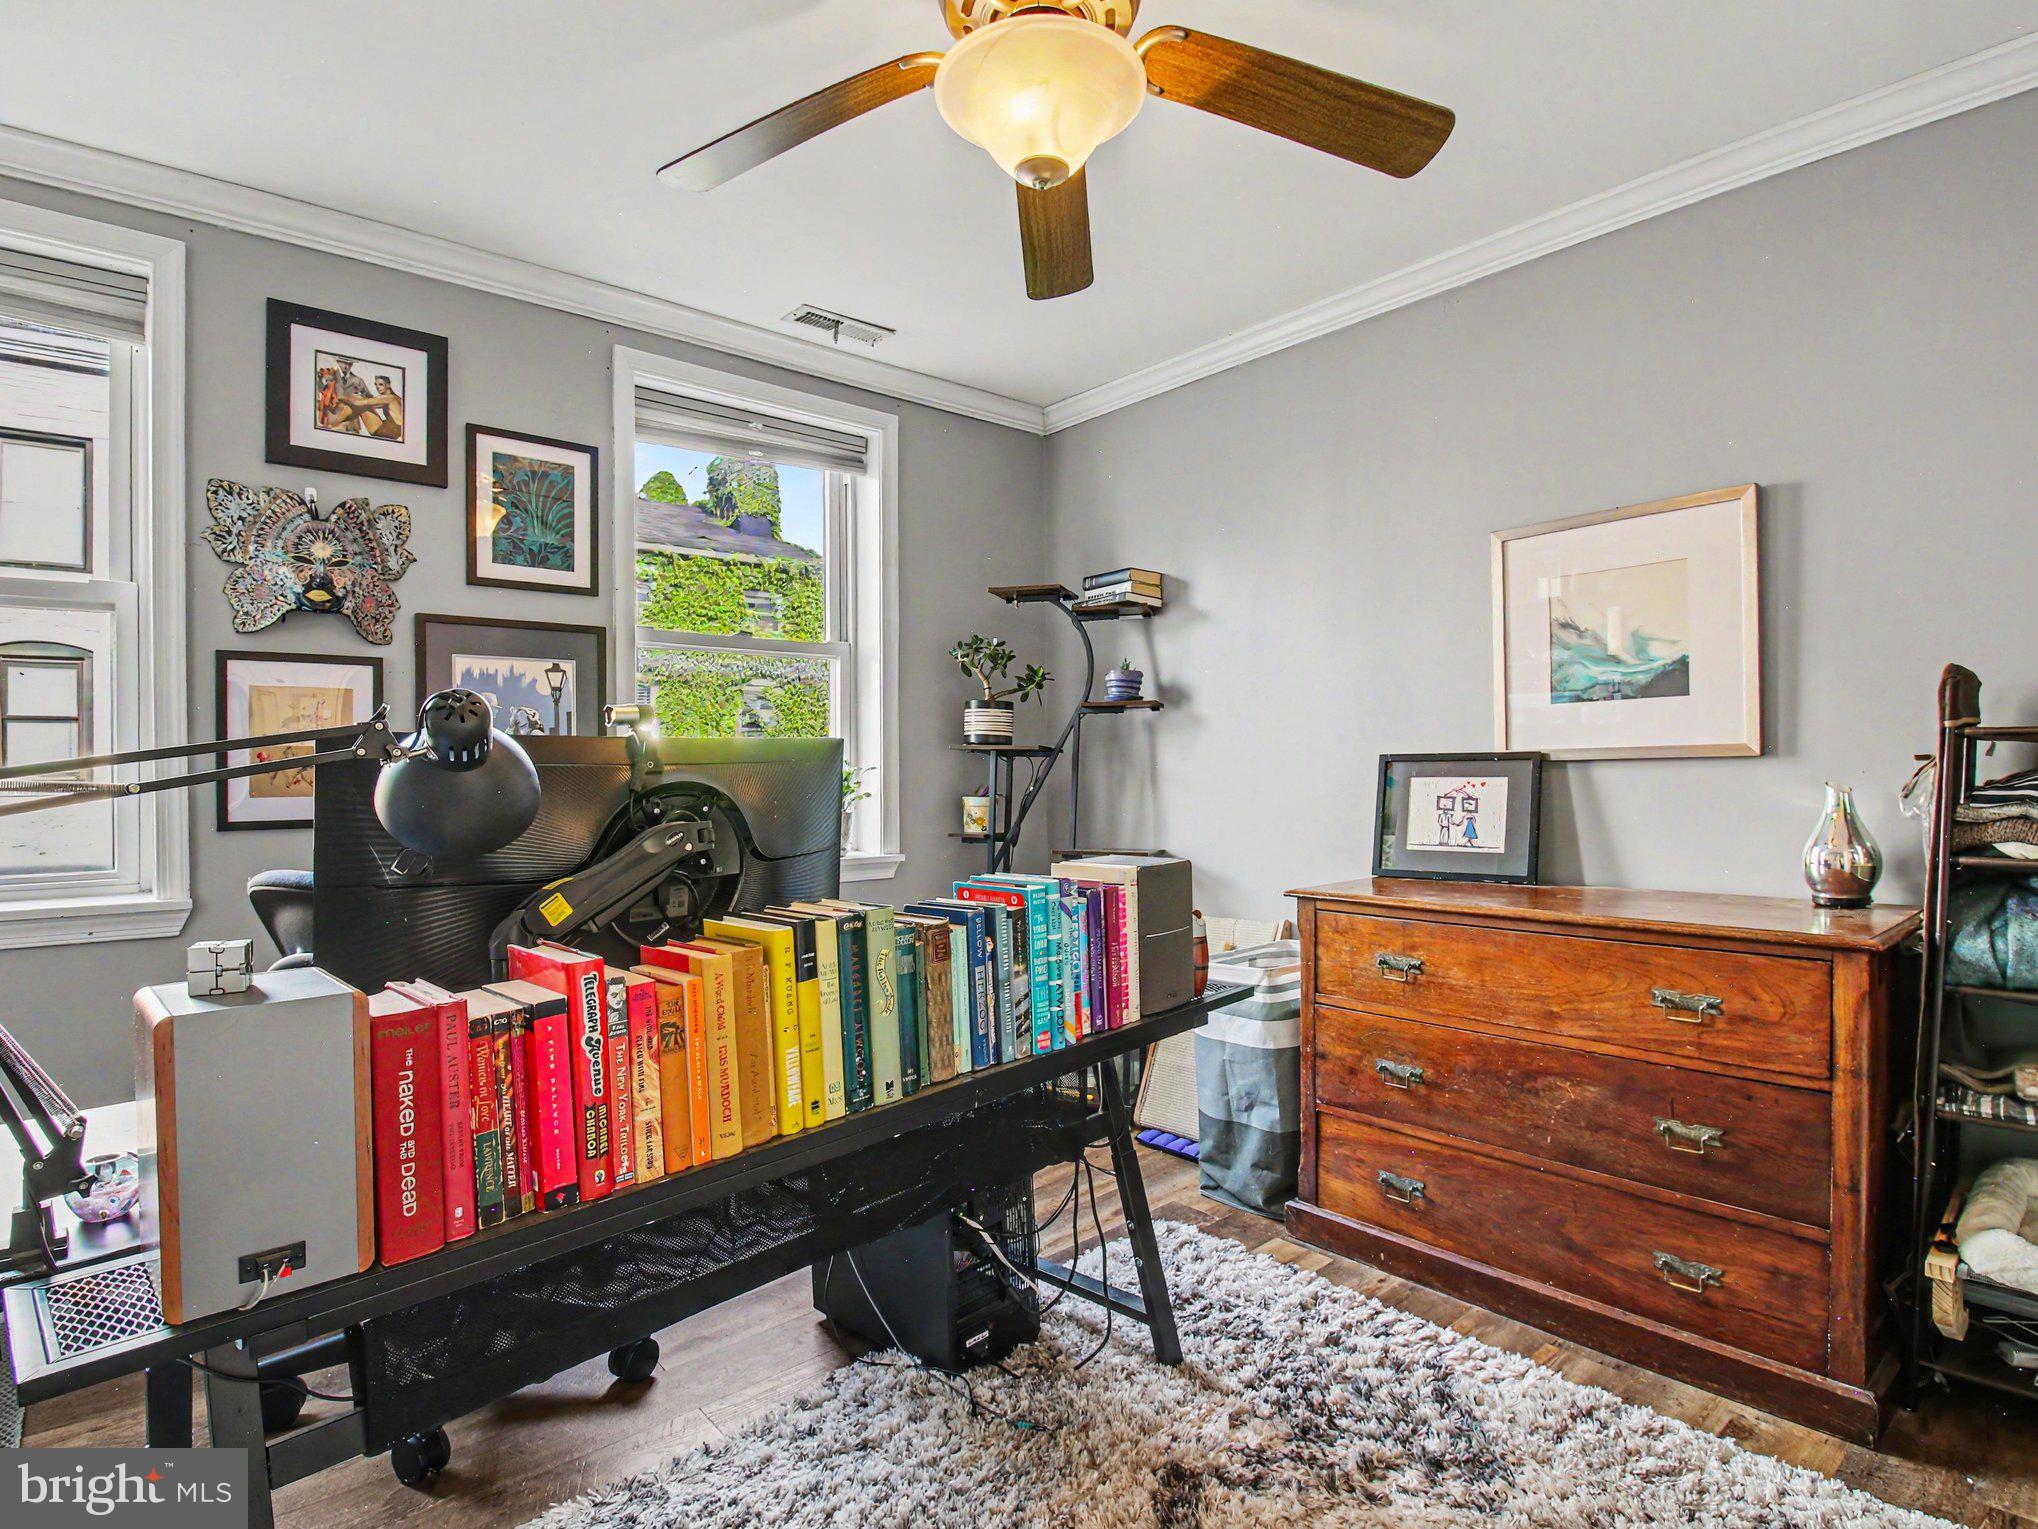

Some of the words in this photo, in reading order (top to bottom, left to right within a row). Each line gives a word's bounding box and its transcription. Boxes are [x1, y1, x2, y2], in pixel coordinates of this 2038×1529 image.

[850, 944, 862, 1012] MARGARET
[976, 970, 986, 1031] HERZOG
[583, 974, 602, 1034] TELEGRAPH
[716, 1005, 726, 1031] Child
[1056, 984, 1064, 1034] ATWOOD
[446, 1014, 457, 1051] PAUL
[548, 1040, 556, 1070] FINE
[615, 1043, 626, 1065] THE
[475, 1041, 491, 1086] Women
[585, 1034, 603, 1097] Avenue
[616, 1066, 628, 1091] NEW
[719, 1045, 729, 1067] IRIS
[447, 1055, 460, 1110] AUSTER
[720, 1068, 732, 1123] MURDOCH
[477, 1099, 494, 1123] Love
[501, 1095, 512, 1127] HEART
[549, 1077, 559, 1136] BALANCE
[598, 1105, 608, 1154] MICHAEL
[617, 1094, 629, 1123] YORK
[586, 1110, 596, 1158] CHABON
[480, 1141, 495, 1193] LAWRENCE
[505, 1152, 516, 1188] MATTER
